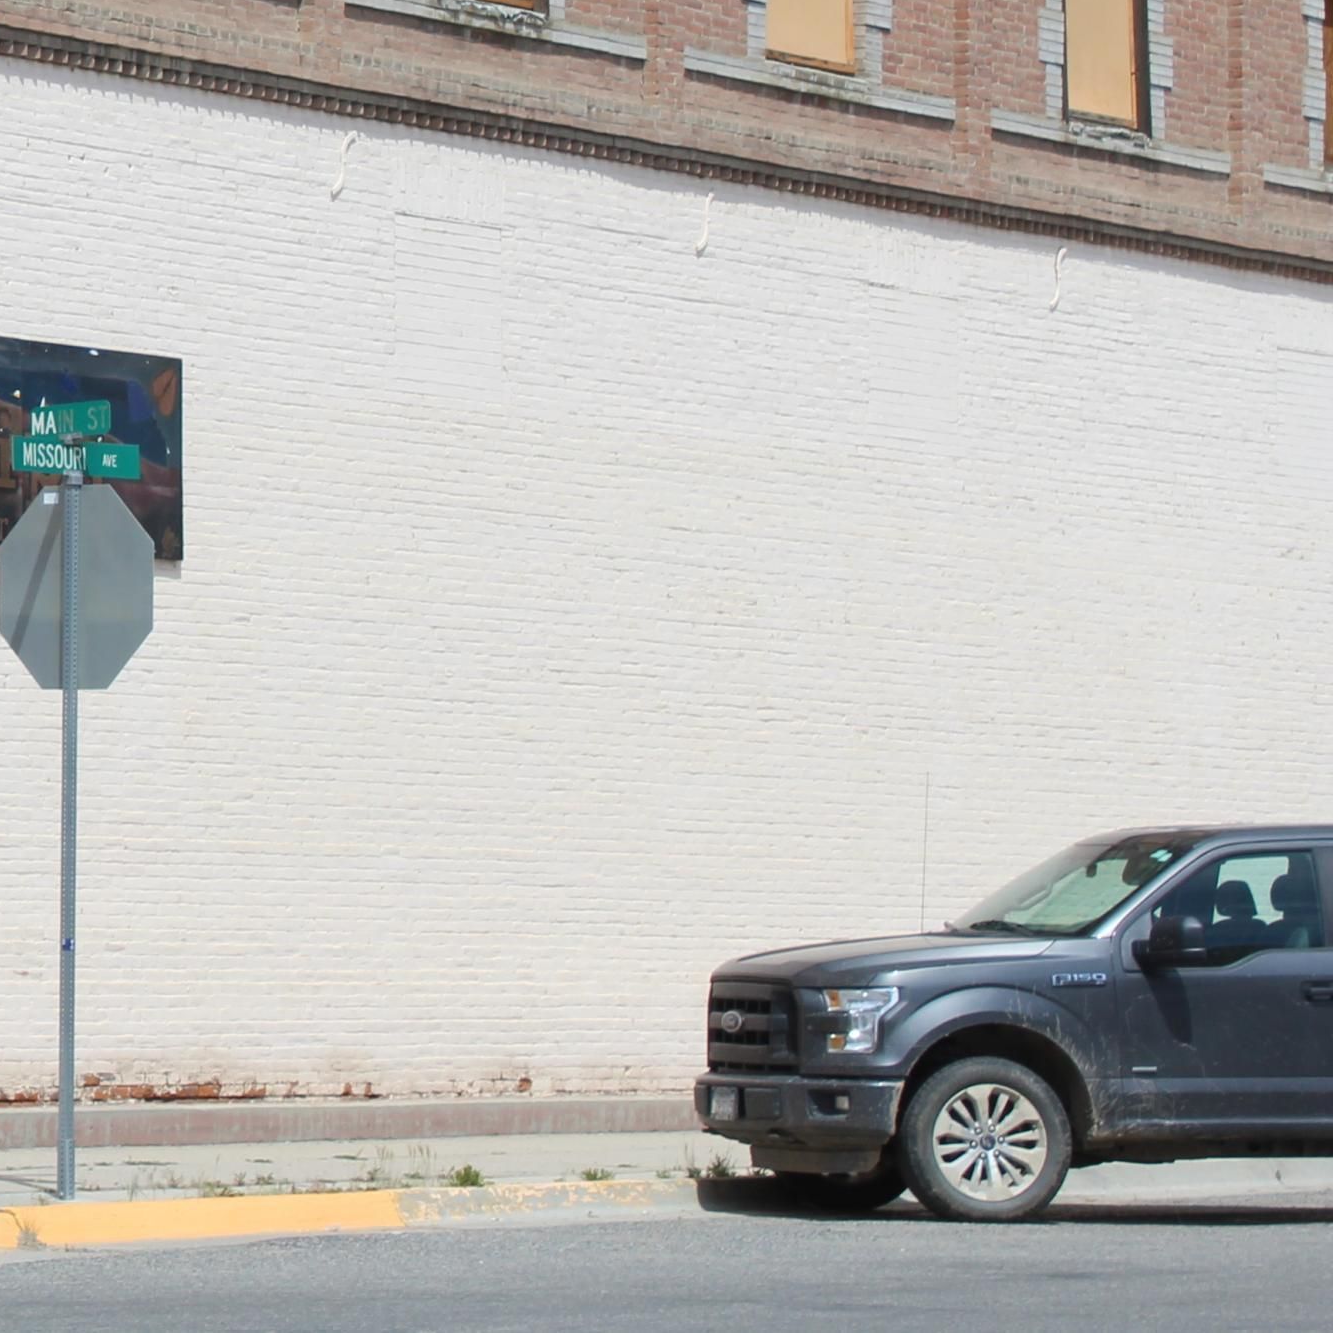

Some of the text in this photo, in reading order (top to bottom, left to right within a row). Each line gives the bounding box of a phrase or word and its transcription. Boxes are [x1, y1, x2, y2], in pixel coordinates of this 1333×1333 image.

[31, 405, 109, 436] MAIN ST
[23, 441, 118, 471] MISSOURI AVE
